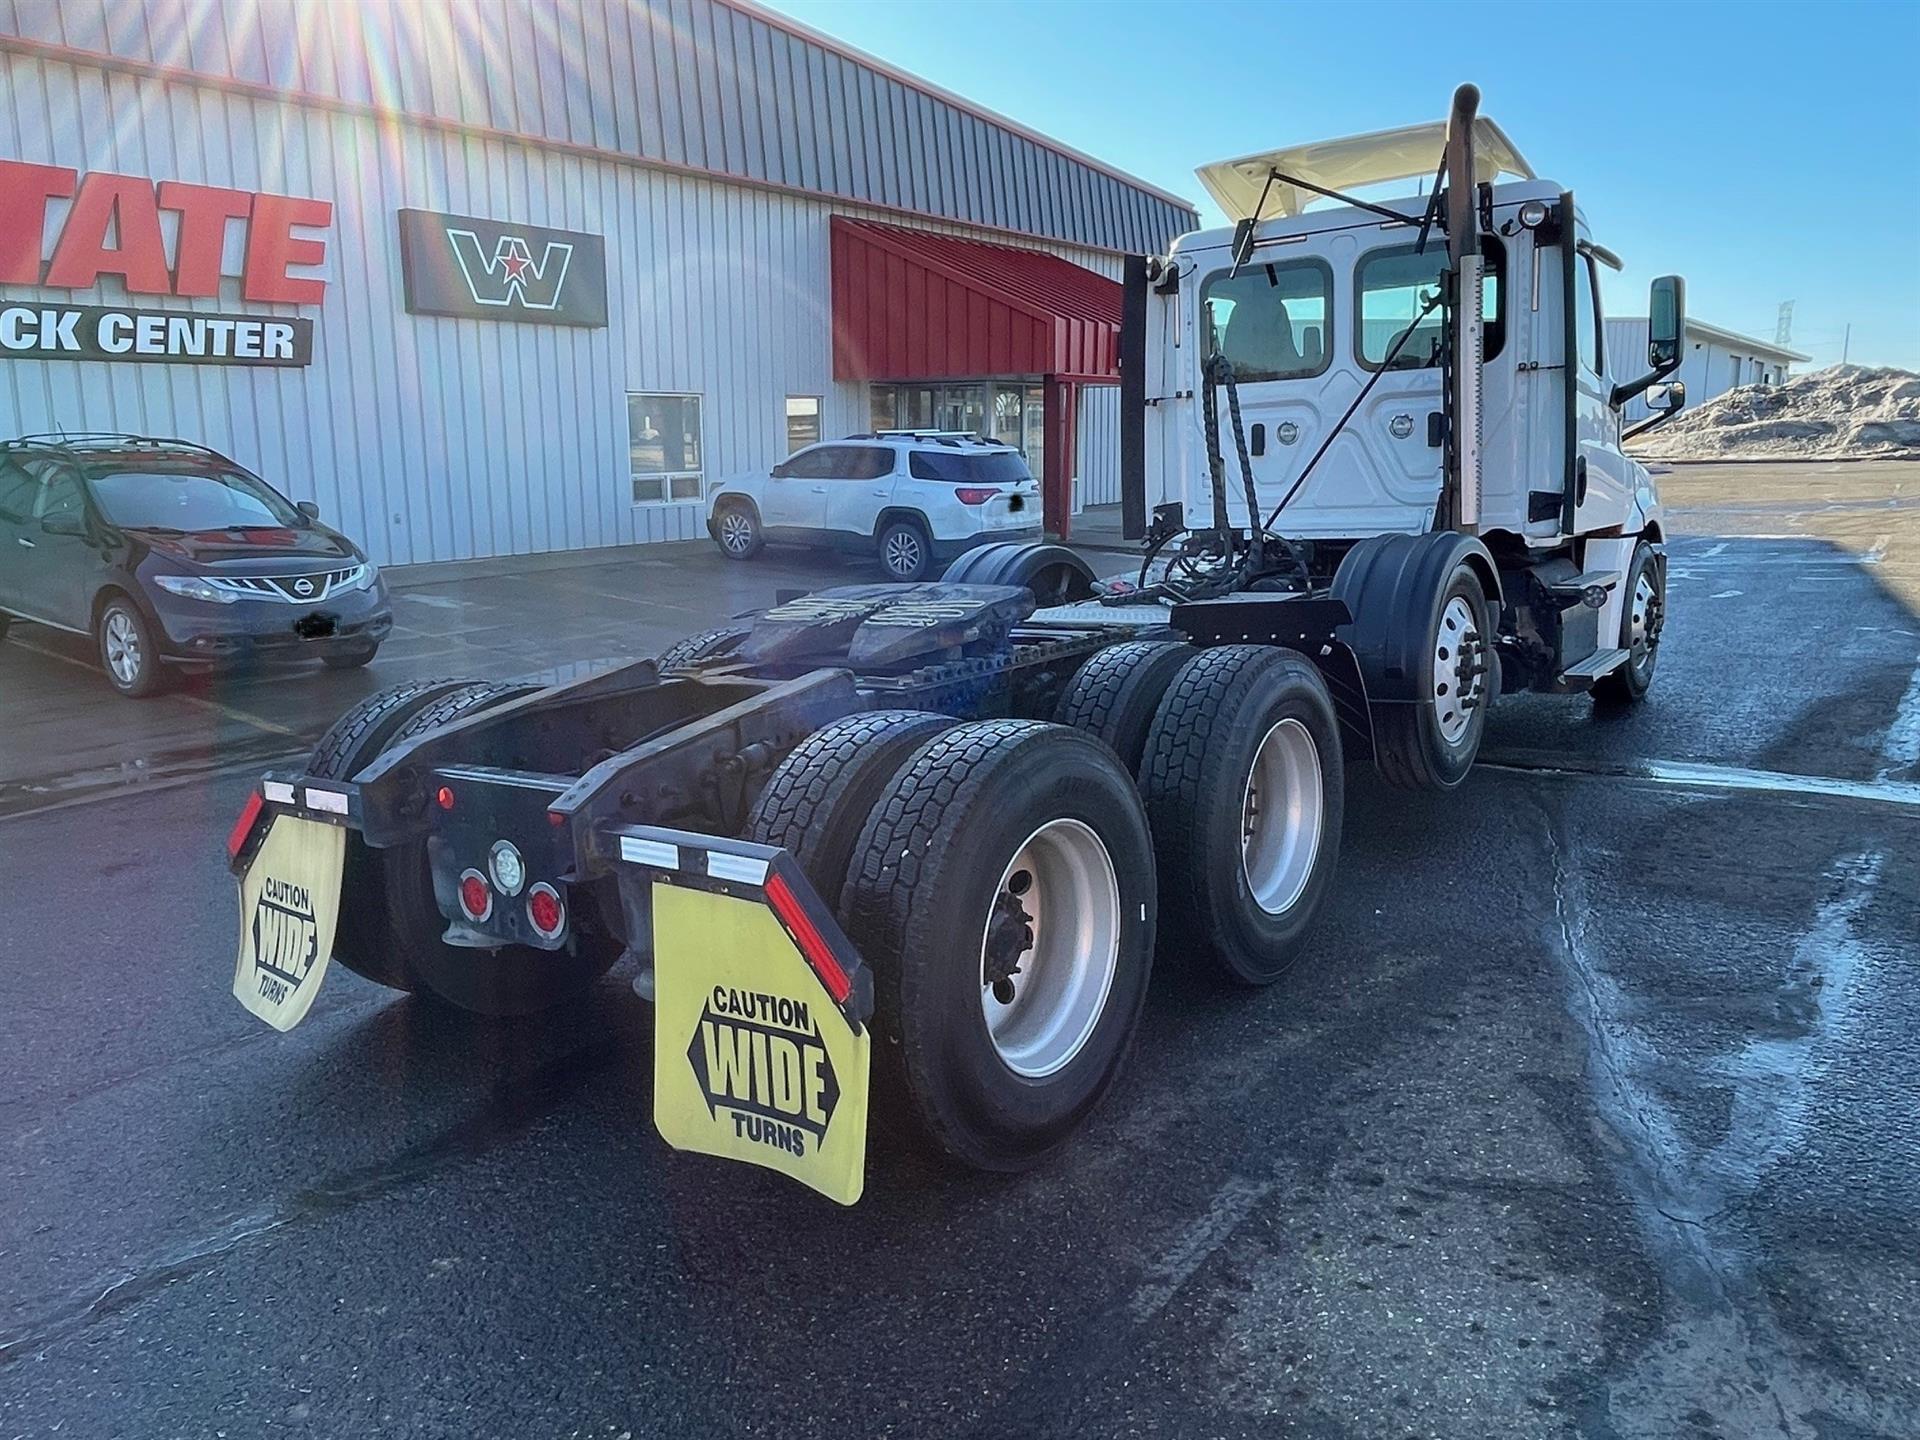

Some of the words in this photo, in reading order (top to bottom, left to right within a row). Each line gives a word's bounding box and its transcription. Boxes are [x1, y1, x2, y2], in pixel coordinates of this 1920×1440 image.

[0, 307, 82, 351] CK
[98, 312, 294, 359] CENTER
[266, 877, 309, 910] CAUTION
[258, 904, 315, 981] WIDE
[258, 974, 288, 1006] TURNS
[713, 985, 809, 1031] CAUTION
[702, 1019, 827, 1126] WIDE
[731, 1111, 804, 1157] TURNS
